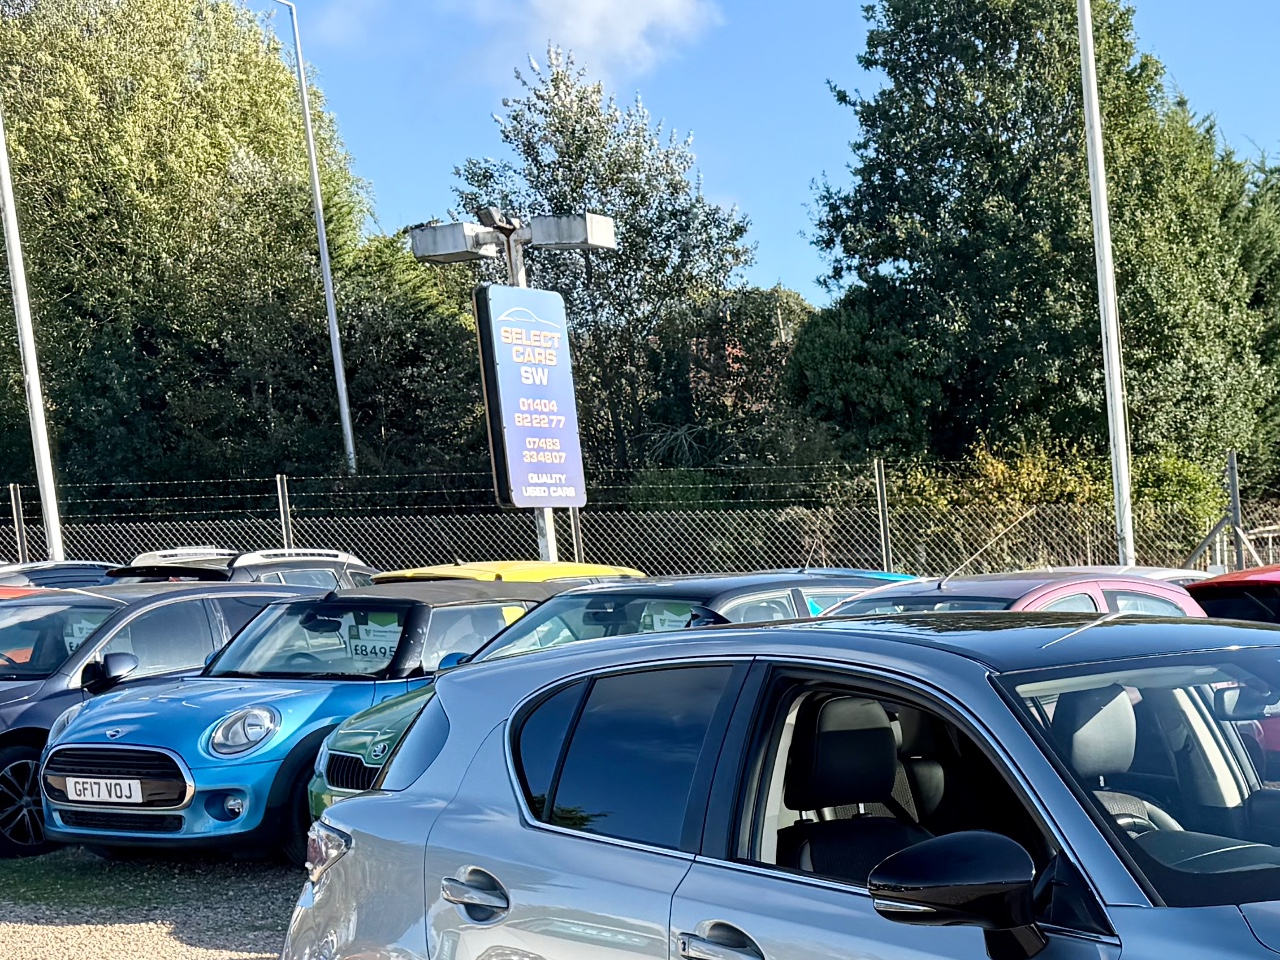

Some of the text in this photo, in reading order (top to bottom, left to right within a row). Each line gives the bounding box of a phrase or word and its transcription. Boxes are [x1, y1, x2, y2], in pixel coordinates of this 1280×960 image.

[500, 326, 561, 349] SELECT
[512, 346, 557, 367] CARS
[520, 366, 549, 386] SW
[519, 397, 558, 413] 01404
[522, 450, 567, 464] 334807
[527, 472, 567, 484] QUALITY
[522, 486, 576, 498] USED CARS
[73, 781, 133, 799] GF17 VOJ
